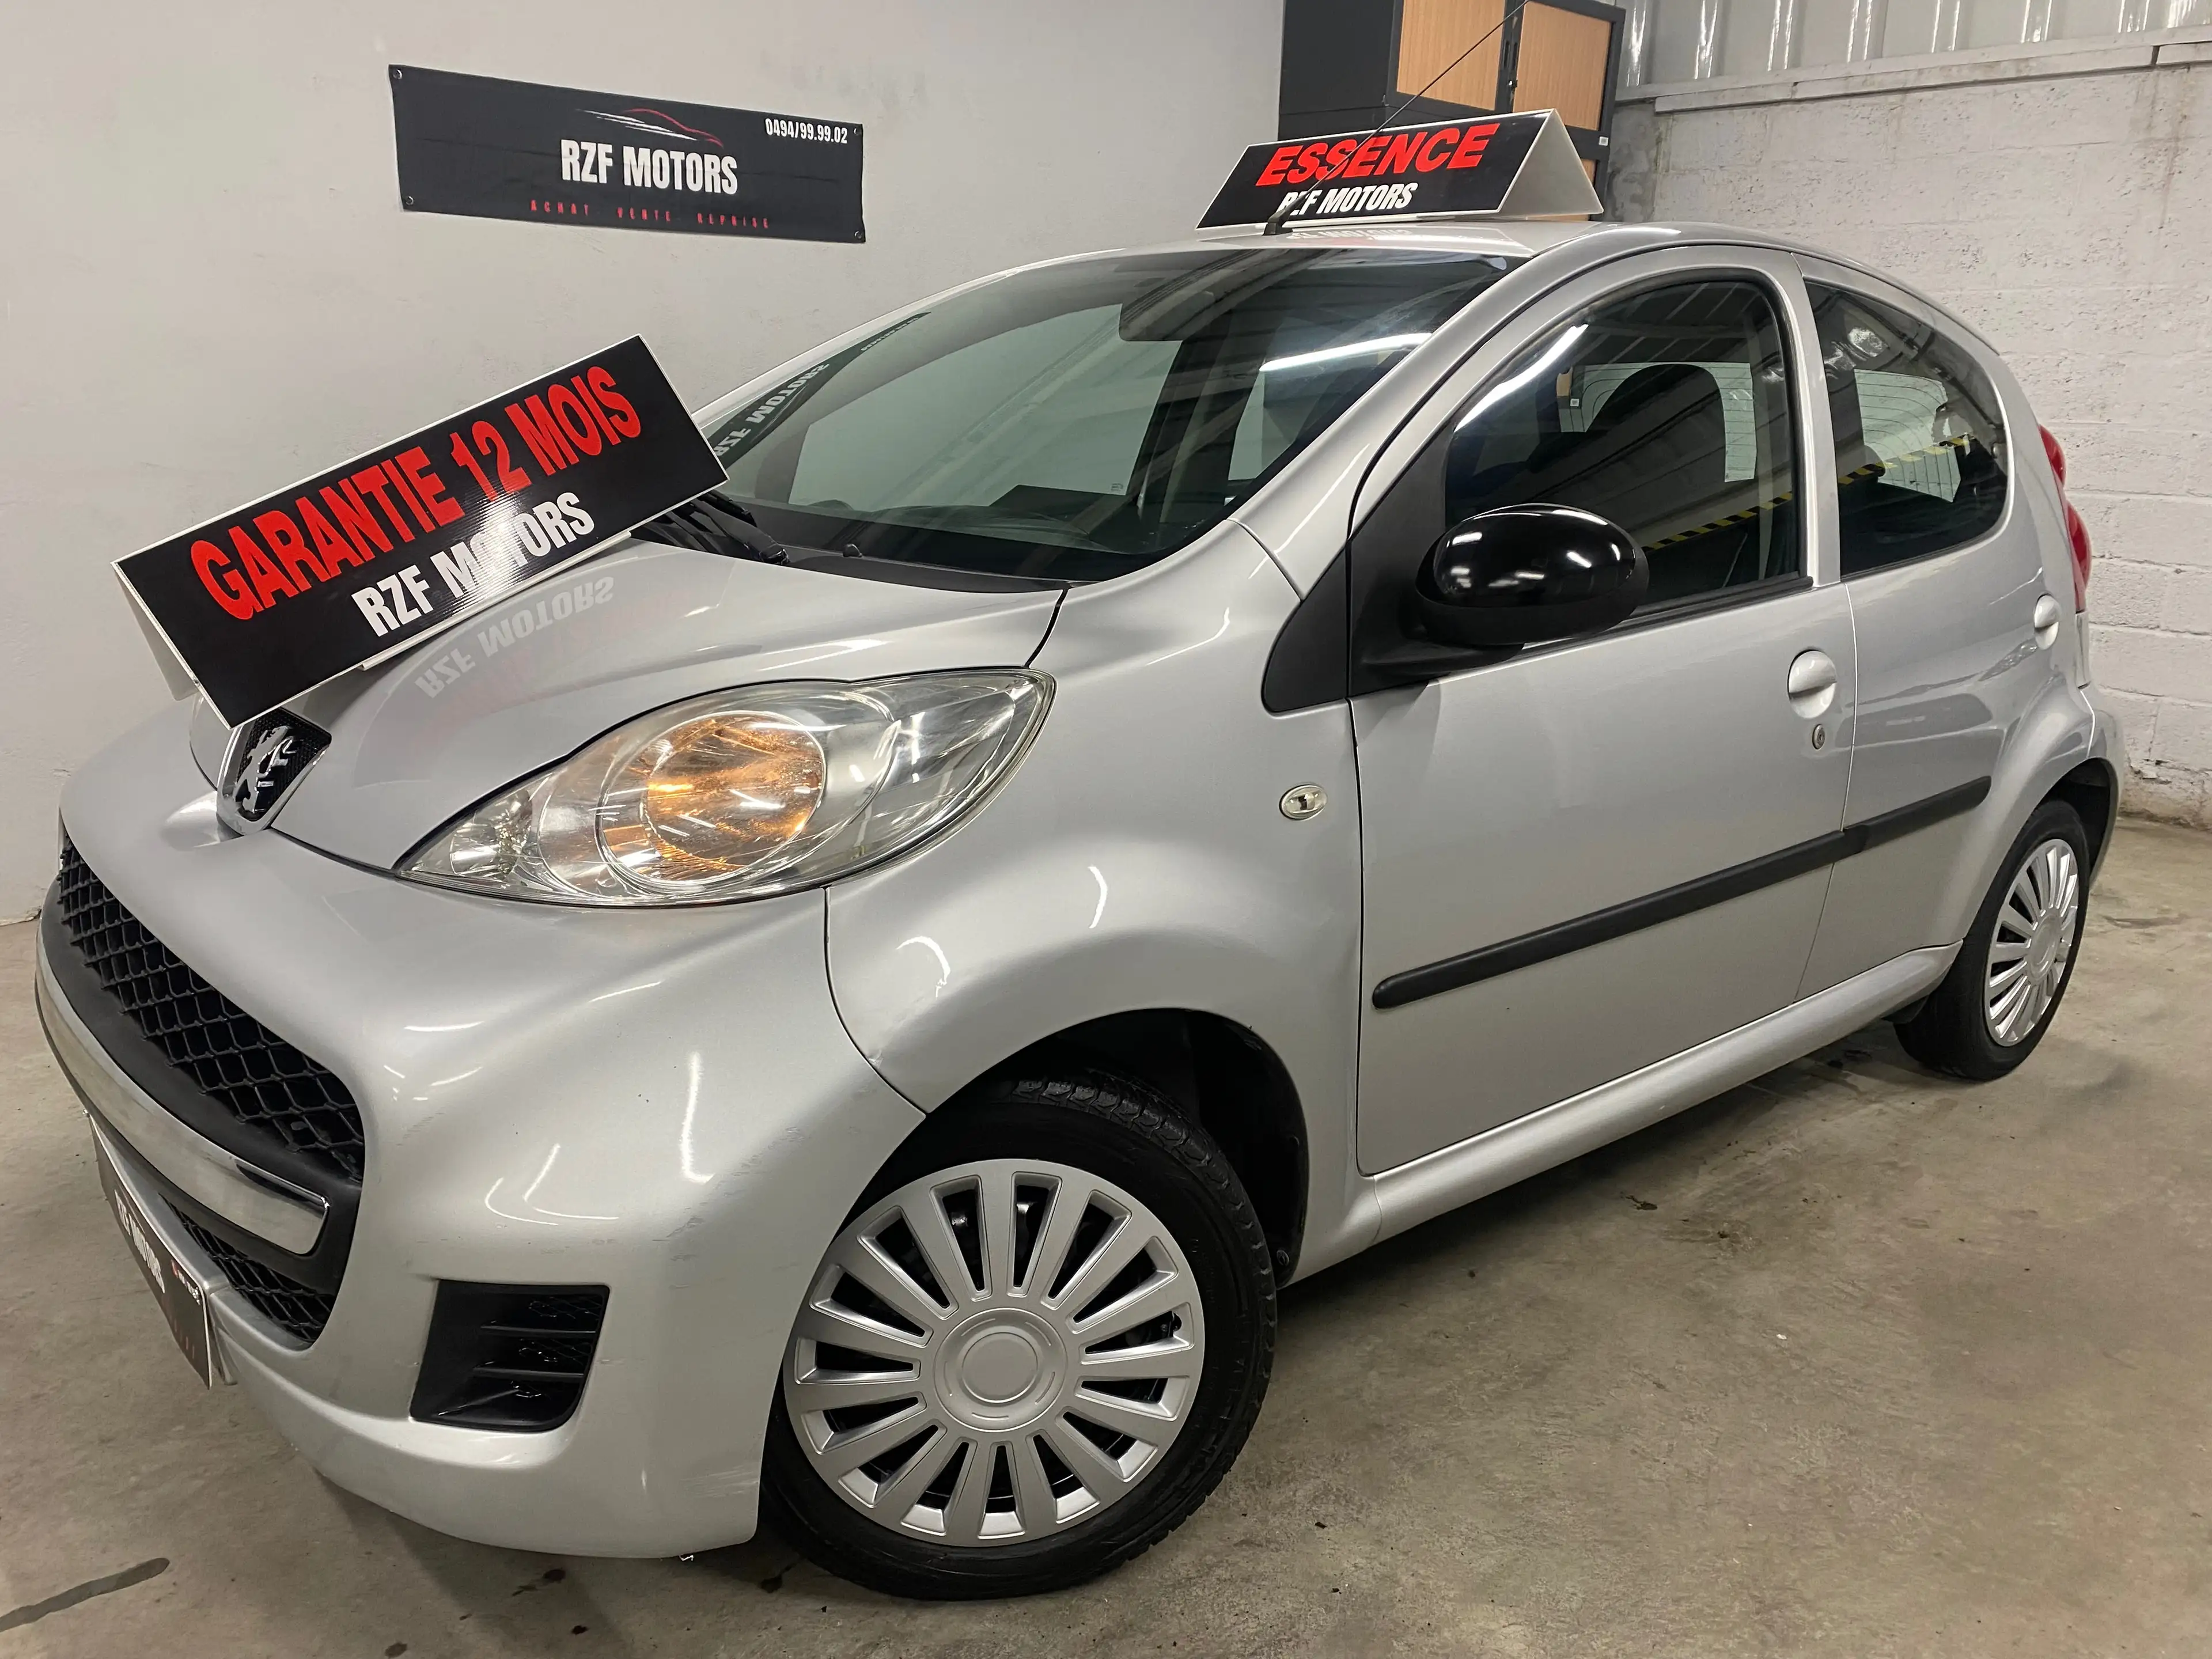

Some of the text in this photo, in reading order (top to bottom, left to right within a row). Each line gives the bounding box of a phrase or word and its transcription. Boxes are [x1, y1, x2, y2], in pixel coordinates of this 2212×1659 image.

[764, 118, 848, 144] 0494/99.99.02
[1255, 122, 1501, 187] ESSENCE
[560, 139, 738, 195] RZF MOTORS
[530, 199, 769, 229] ACHAT VENTE REPRISE
[1316, 182, 1418, 214] MOTORS
[190, 365, 642, 620] GARANTIE 12 MOIS
[351, 564, 435, 637] RZF
